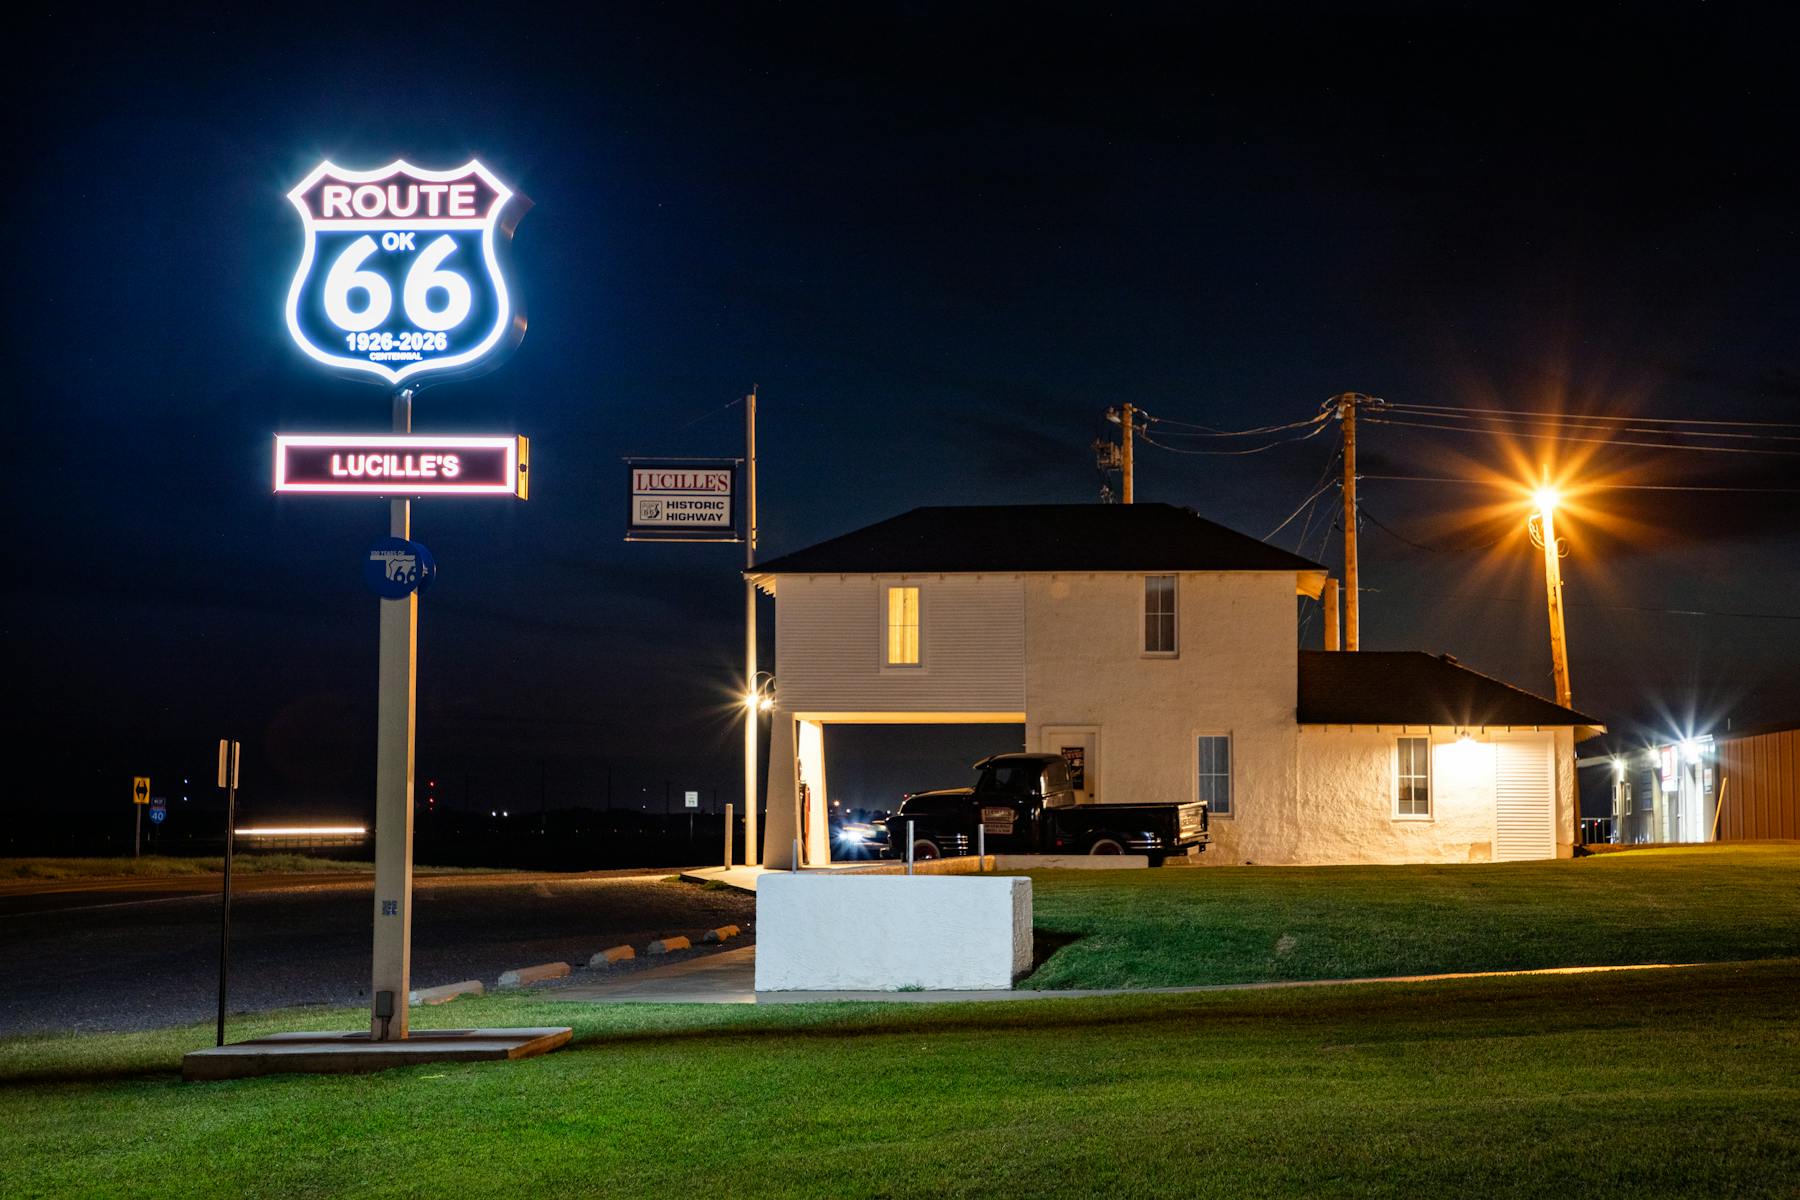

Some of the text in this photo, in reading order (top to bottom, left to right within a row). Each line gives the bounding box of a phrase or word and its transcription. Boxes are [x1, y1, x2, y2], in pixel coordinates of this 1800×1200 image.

[322, 184, 476, 218] ROUTE
[382, 232, 415, 251] OK
[324, 234, 472, 332] 66
[346, 332, 447, 351] 1926-2026
[369, 352, 423, 361] CENTENNIAL
[331, 454, 460, 477] LUCILLE'S
[635, 473, 728, 492] LUCILLE'S
[666, 501, 725, 510] HISTORIC
[666, 512, 724, 521] HIGHWAY
[393, 566, 416, 583] 66
[152, 812, 164, 821] 40
